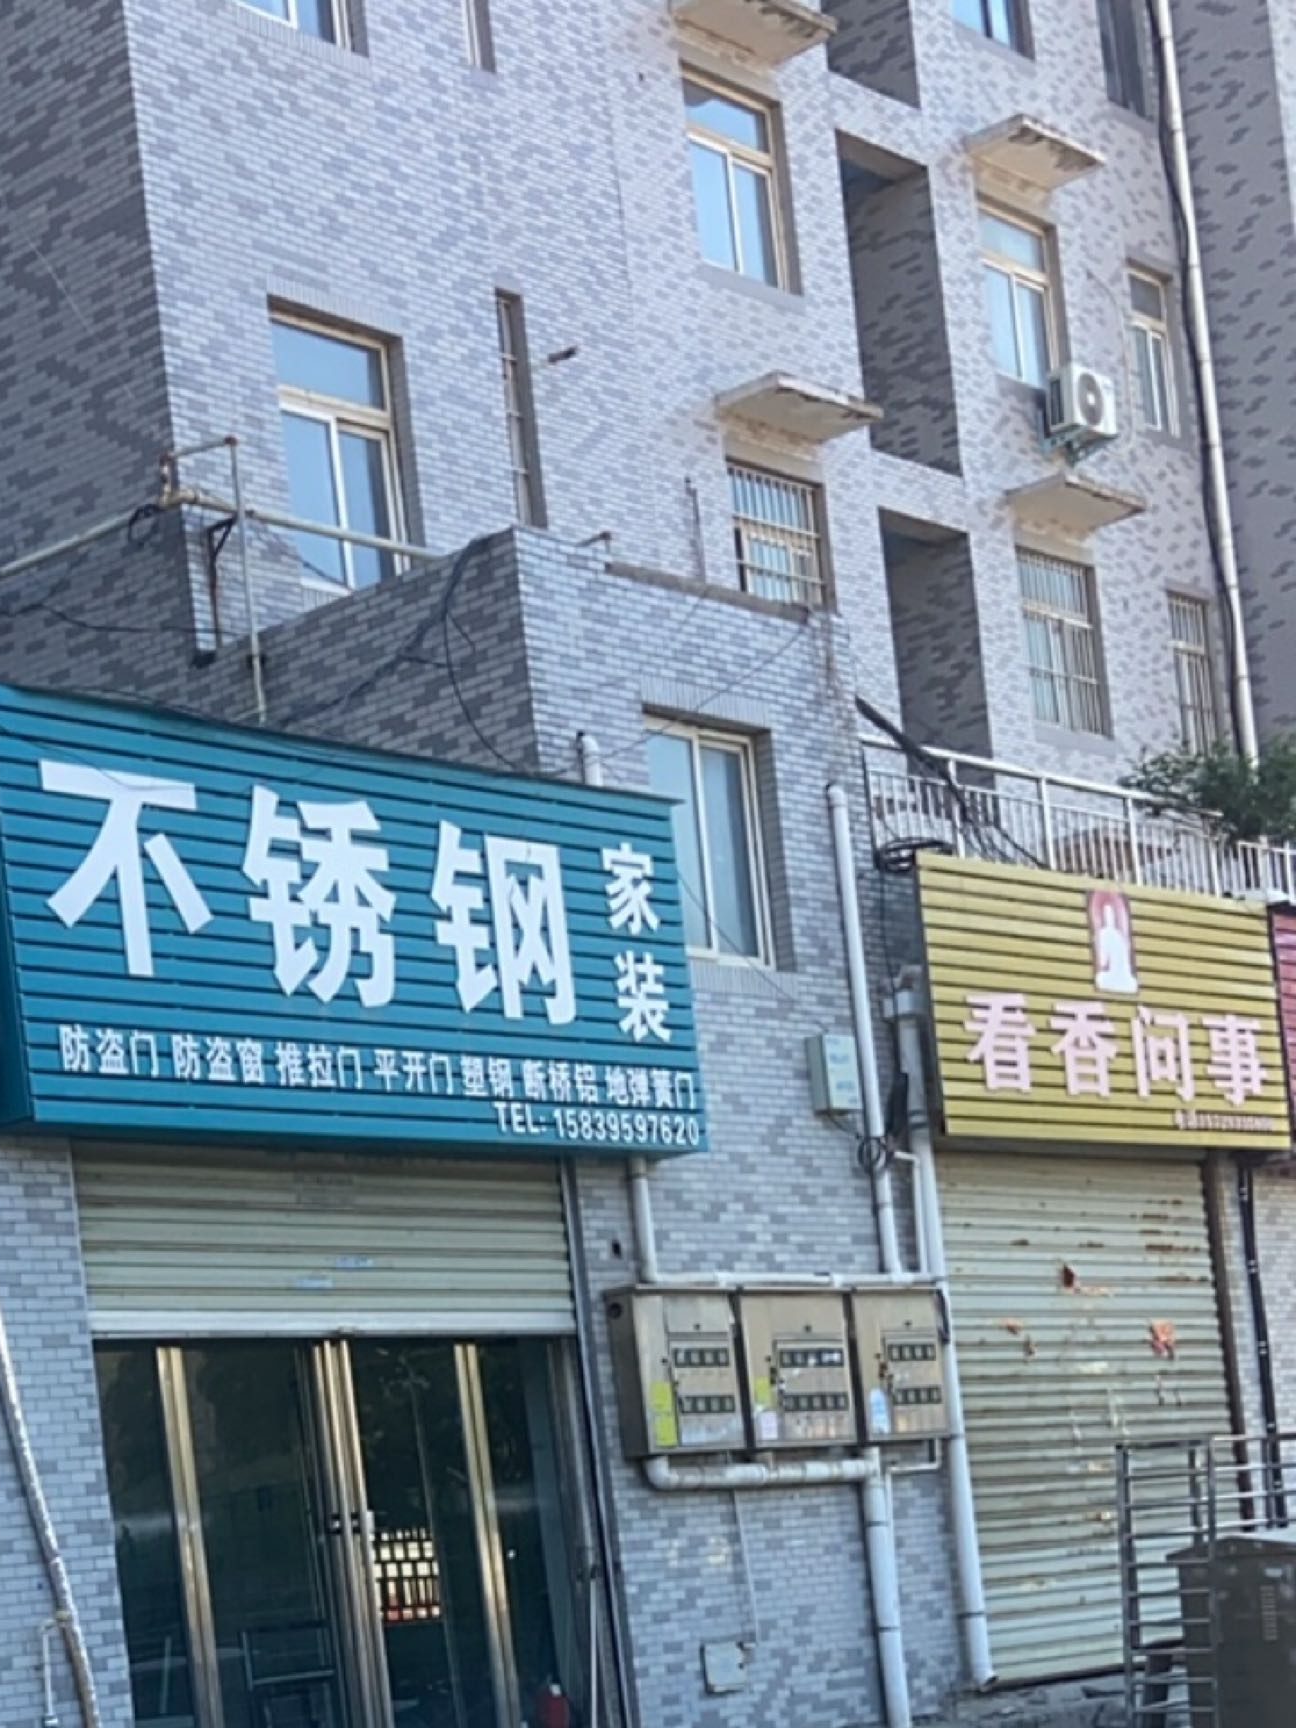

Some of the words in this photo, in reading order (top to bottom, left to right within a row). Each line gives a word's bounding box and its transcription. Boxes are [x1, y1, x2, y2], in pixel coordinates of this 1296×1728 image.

[38, 758, 578, 1024] 不锈钢
[601, 840, 673, 1042] 家装
[58, 1023, 160, 1078] 防盗门
[170, 1032, 266, 1085] 防盗窗
[274, 1040, 364, 1090] 推拉门
[373, 1048, 454, 1096] 平开门
[962, 992, 1270, 1106] 看香问事
[493, 1102, 547, 1134] TEL:
[553, 1108, 700, 1146] 15839597620
